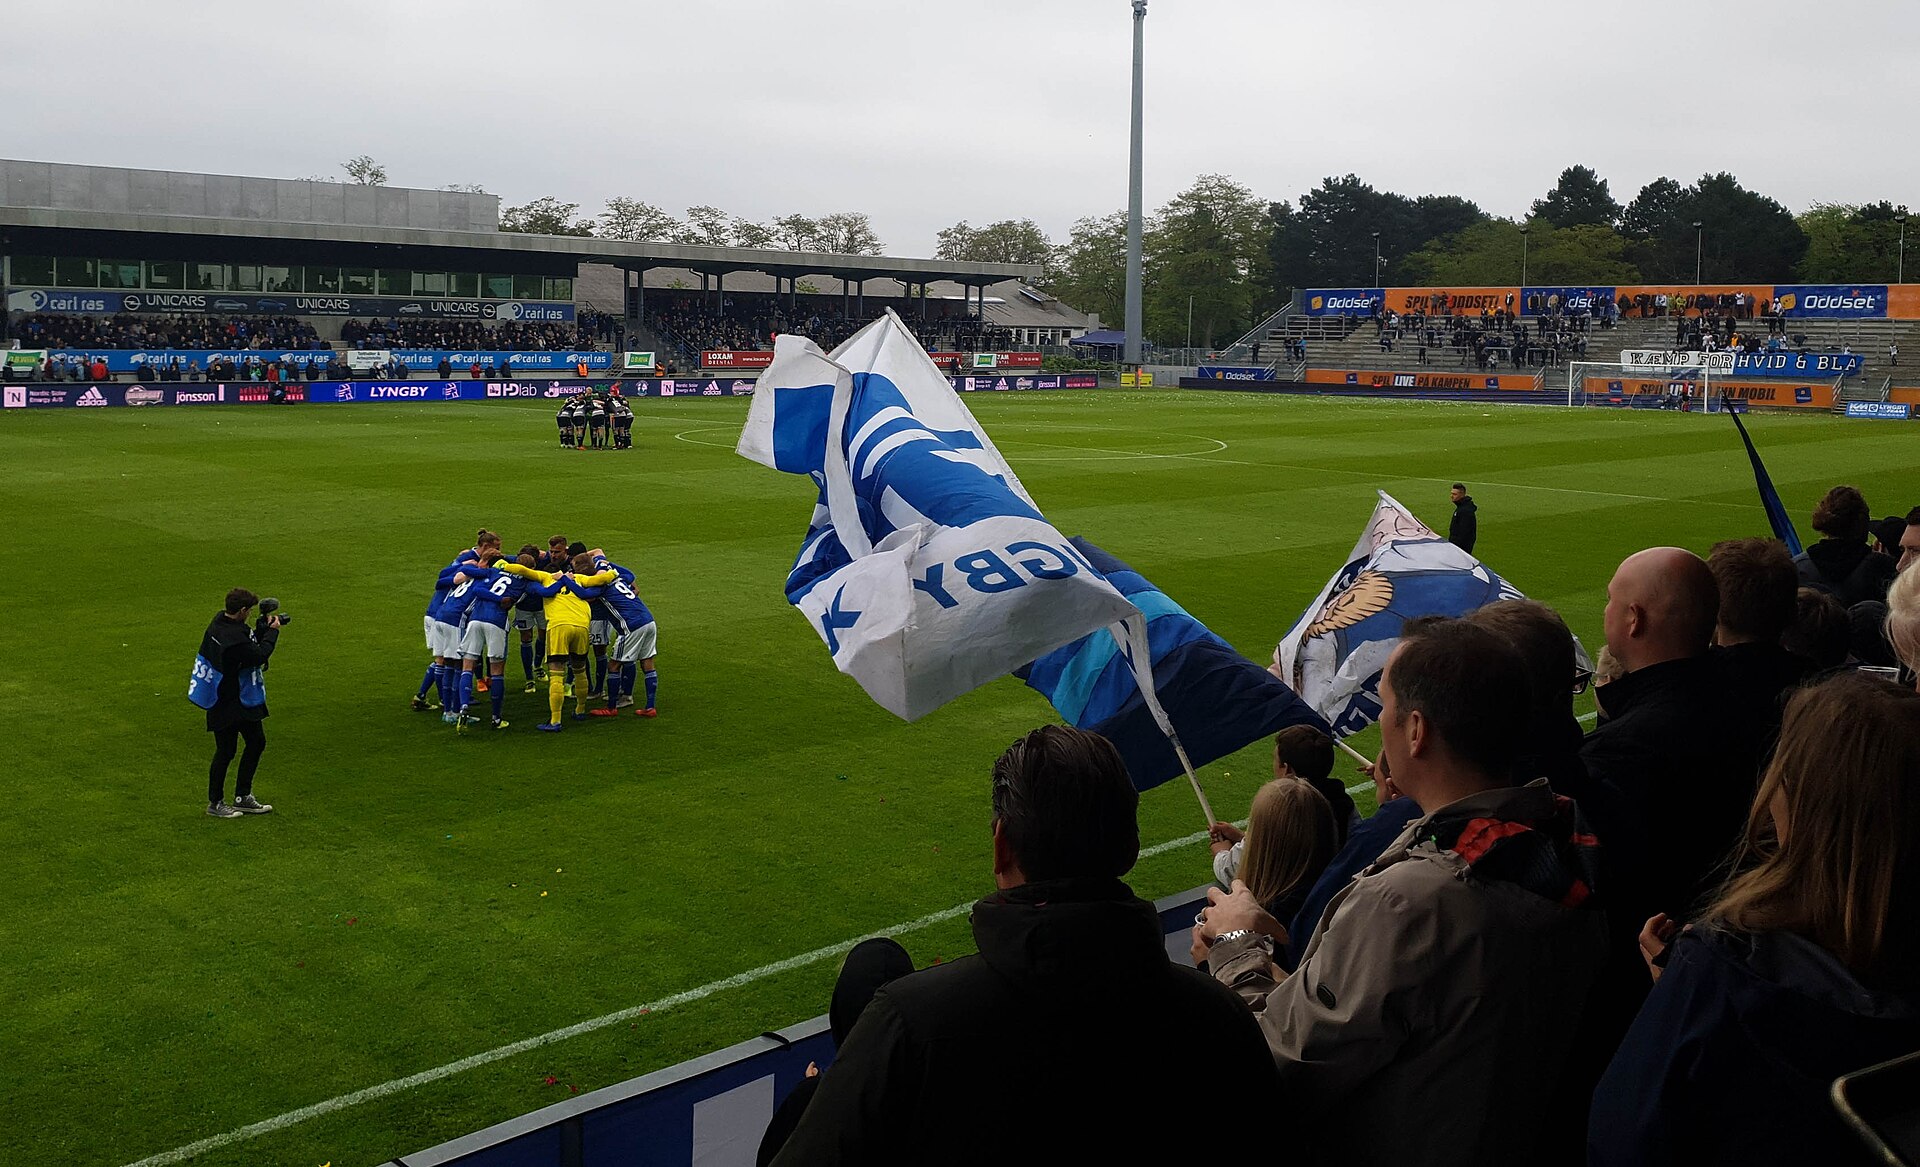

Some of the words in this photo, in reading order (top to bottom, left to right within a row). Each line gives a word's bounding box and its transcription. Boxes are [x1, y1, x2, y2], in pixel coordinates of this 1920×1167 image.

[50, 296, 77, 310] carl
[81, 299, 104, 311] ras
[146, 295, 206, 307] UNICARS
[296, 298, 350, 309] UNICARS
[1405, 295, 1429, 309] SPIL
[1804, 295, 1875, 309] Oddset
[431, 302, 480, 313] UNICARS
[525, 307, 544, 319] carl
[547, 310, 563, 319] ras
[148, 353, 167, 363] carl
[314, 355, 329, 363] ras
[401, 353, 417, 363] carl
[419, 355, 433, 363] ras
[463, 354, 479, 363] carl
[480, 355, 494, 363] ras
[522, 354, 537, 363] carl
[538, 355, 552, 363] ras
[578, 354, 593, 363] carl
[594, 355, 606, 363] ras
[1630, 352, 1689, 366] KÆMP
[1697, 353, 1733, 368] FOR
[1737, 355, 1787, 369] HVID
[1795, 355, 1807, 370] &
[1226, 372, 1256, 380] Oddset
[1394, 375, 1415, 387] LIVE
[1431, 376, 1471, 388] KAMPEN
[370, 386, 429, 397] LYNGBY
[703, 388, 722, 396] adidas
[1670, 384, 1694, 397] LIE
[1738, 387, 1776, 400] MOBIL
[76, 397, 108, 407] adidas
[175, 391, 216, 404] jönsson
[489, 576, 512, 597] 6
[614, 581, 636, 600] 9
